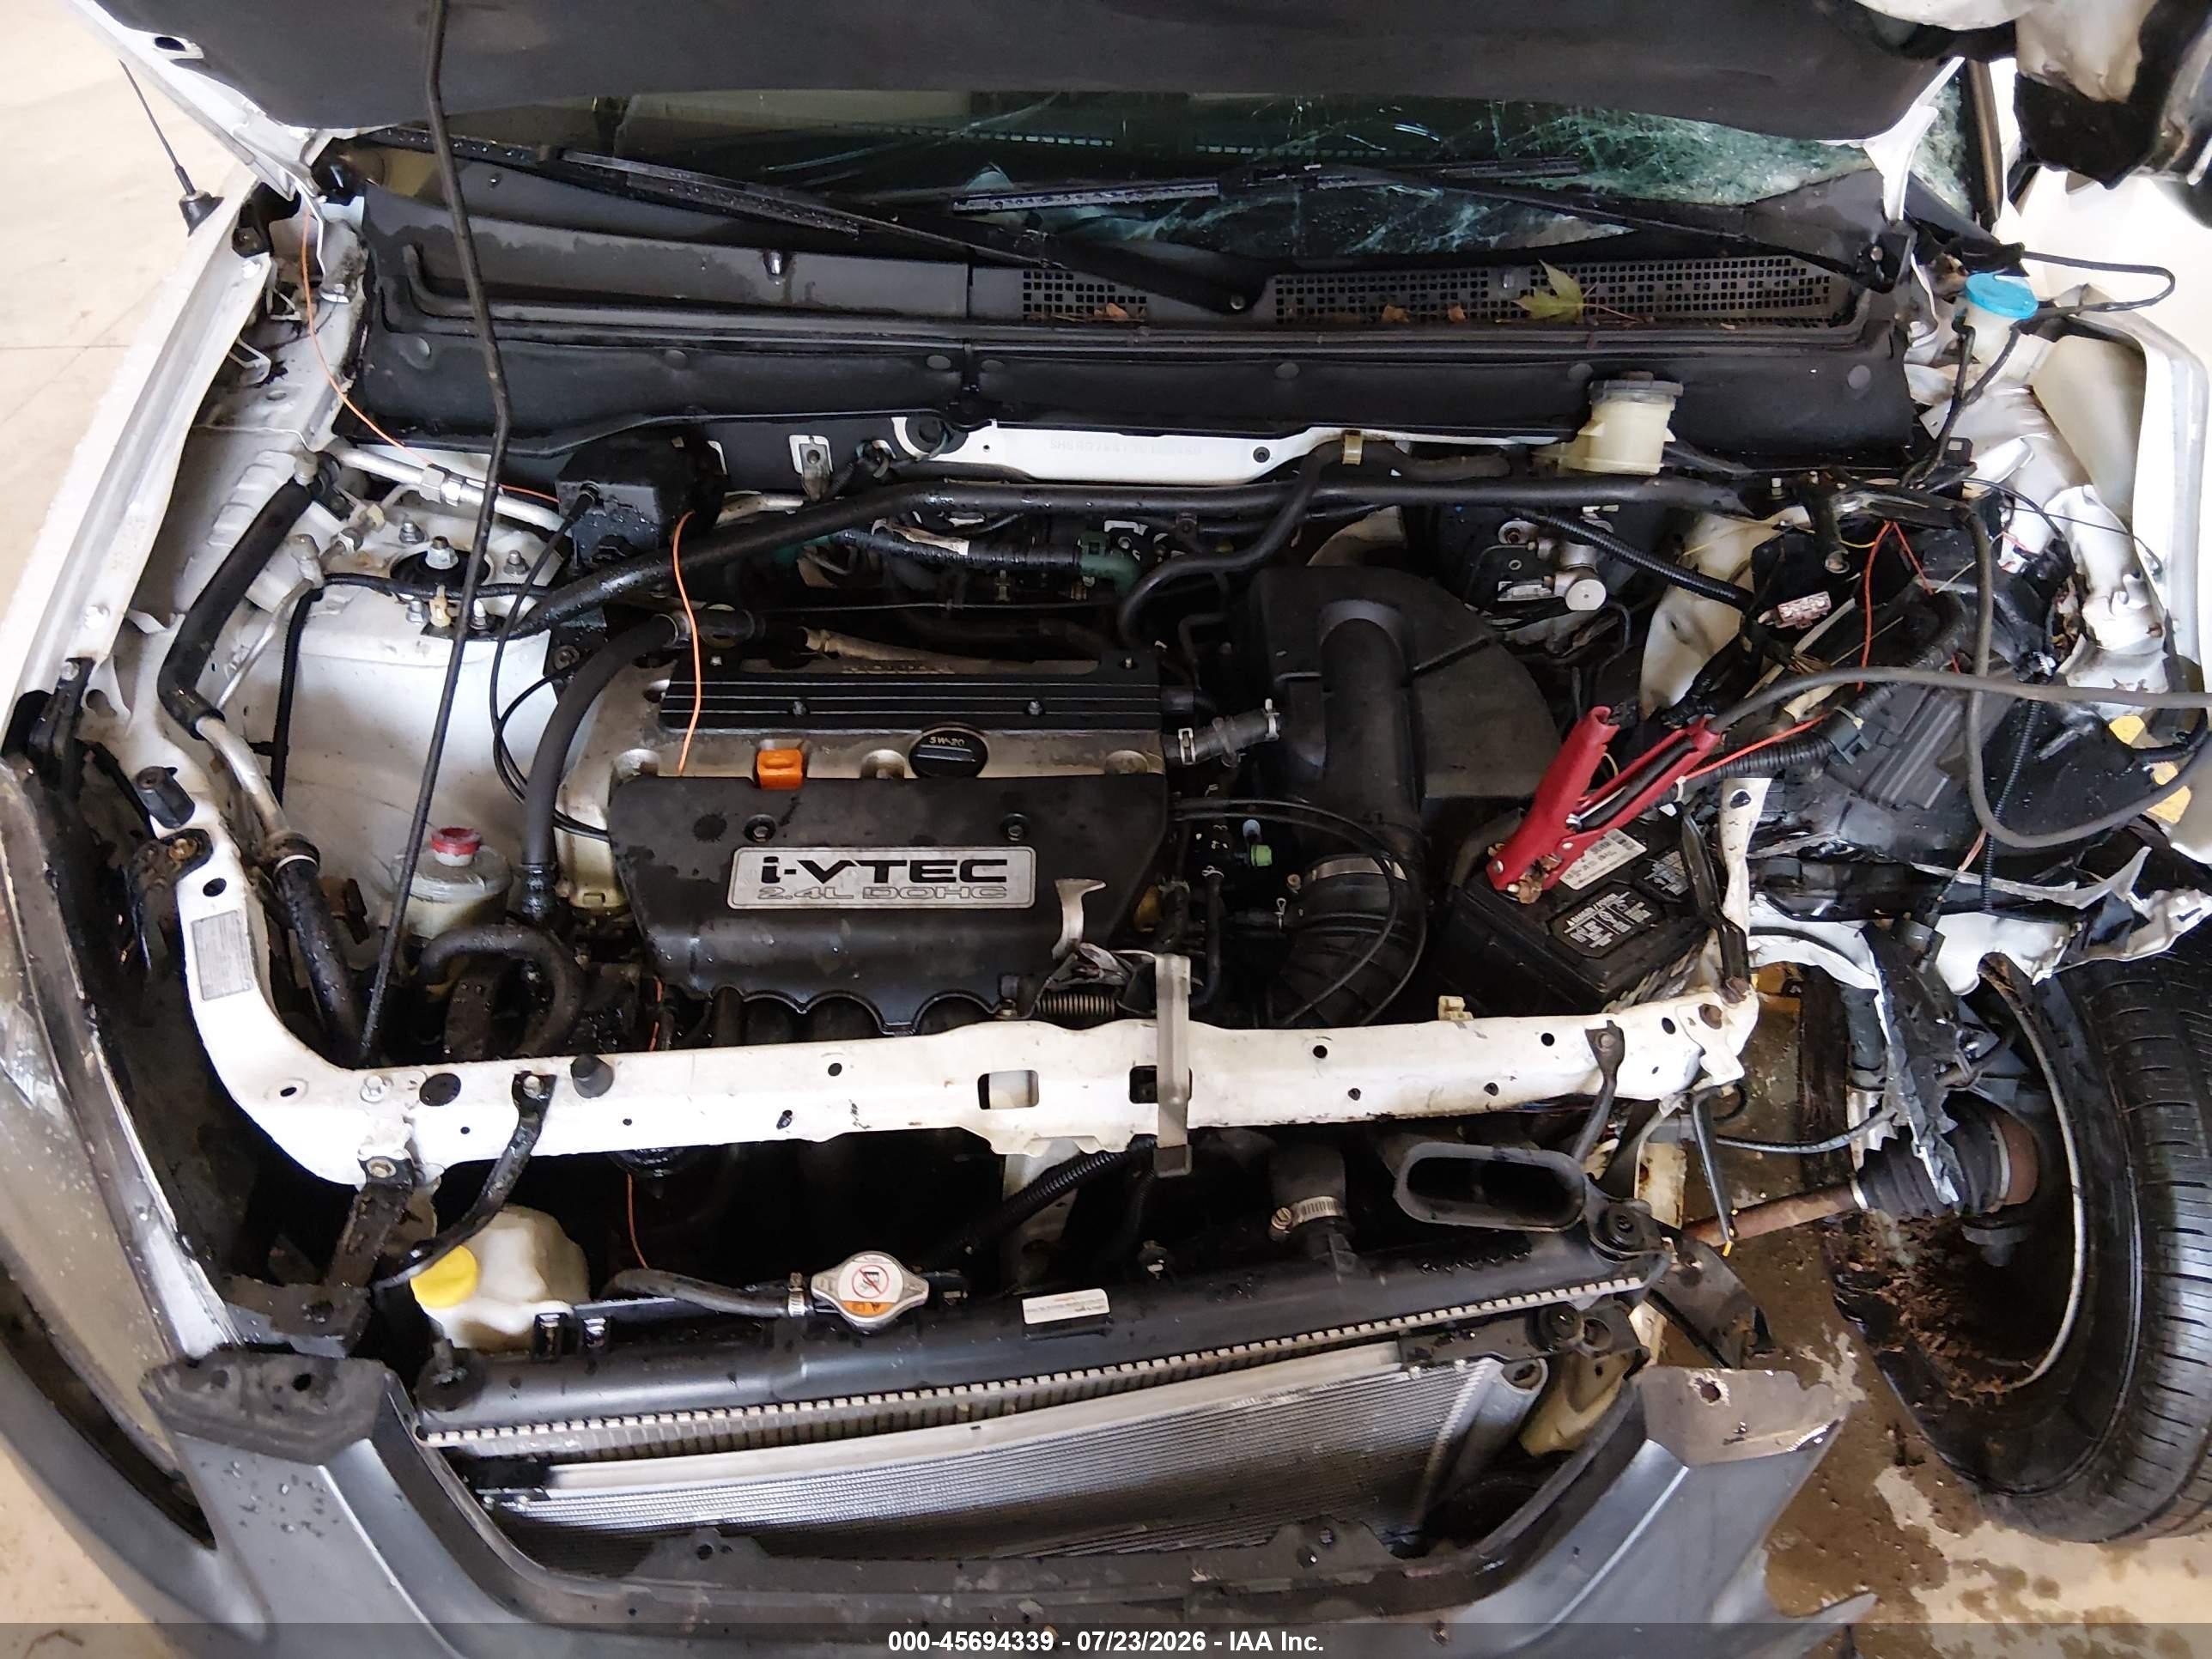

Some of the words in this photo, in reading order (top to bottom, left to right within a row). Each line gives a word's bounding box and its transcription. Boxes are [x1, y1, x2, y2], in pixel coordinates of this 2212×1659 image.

[761, 855, 1007, 884] i-VTEC
[757, 886, 854, 900] 2.4L
[861, 885, 1007, 900] DOHC
